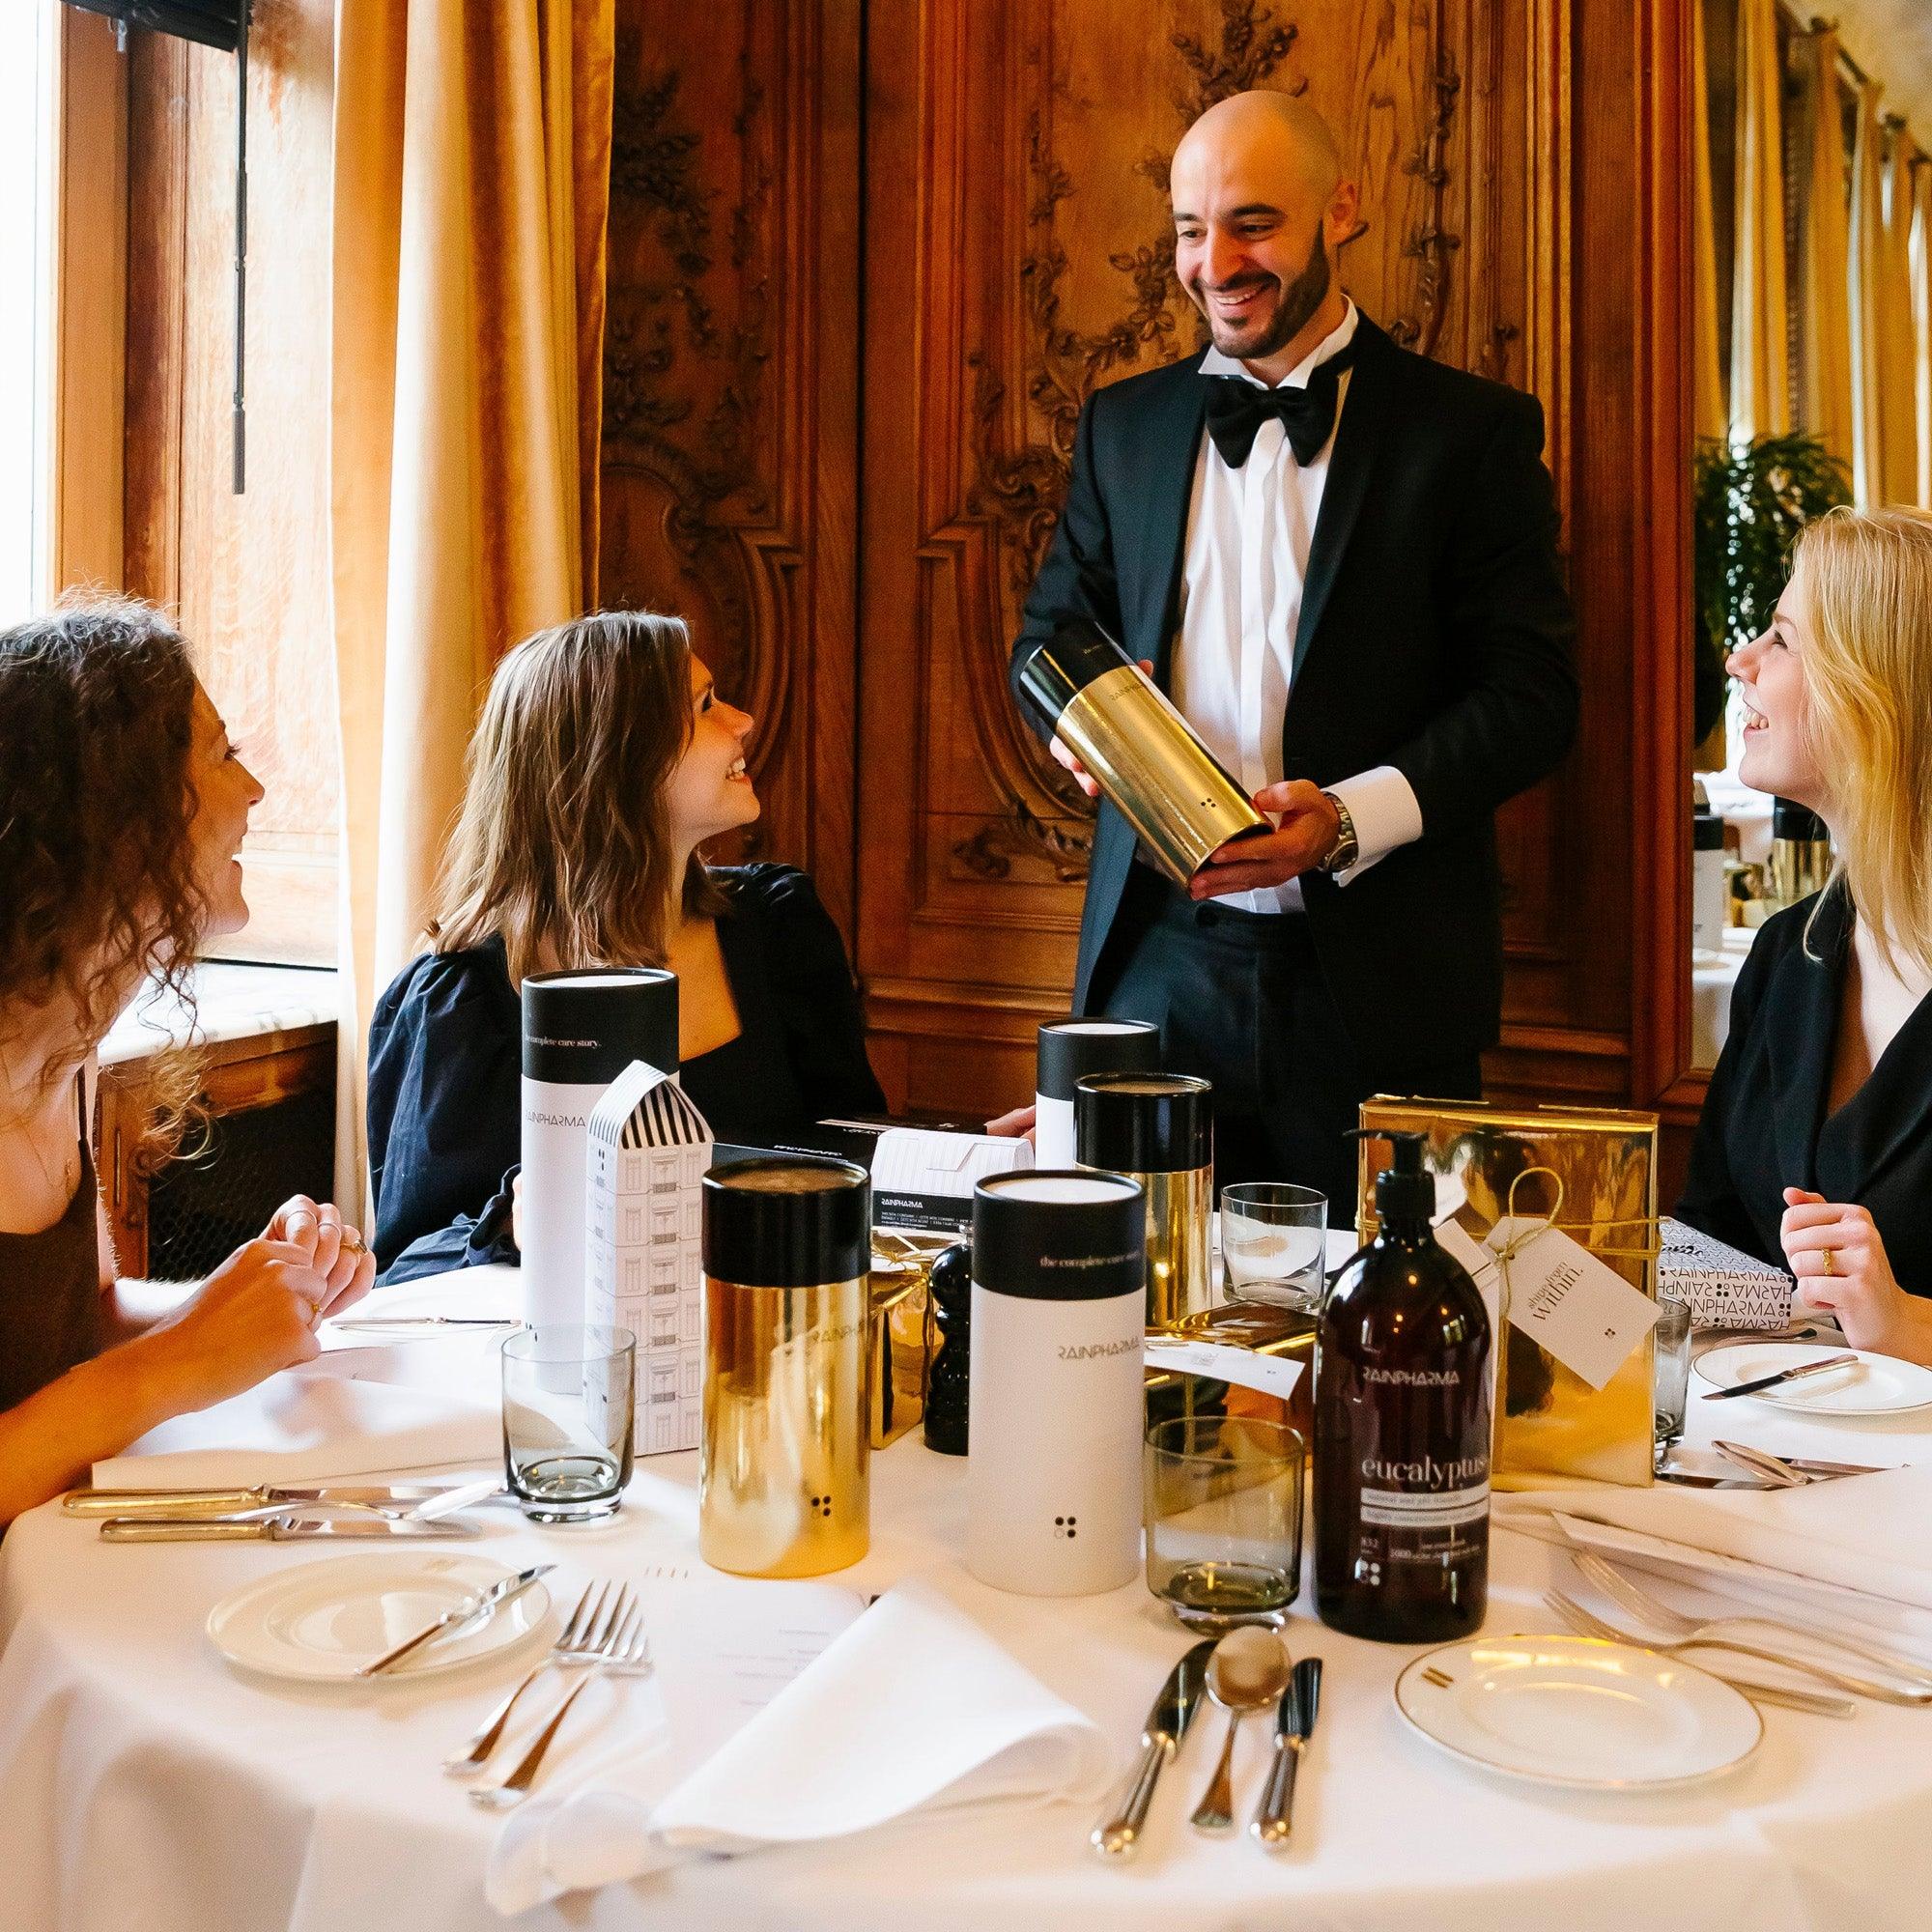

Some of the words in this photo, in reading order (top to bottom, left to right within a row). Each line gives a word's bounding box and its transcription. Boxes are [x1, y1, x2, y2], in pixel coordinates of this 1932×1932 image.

[557, 1038, 576, 1047] care
[1363, 1366, 1460, 1385] RAINPHARMA
[1361, 1454, 1486, 1489] eucalyptus
